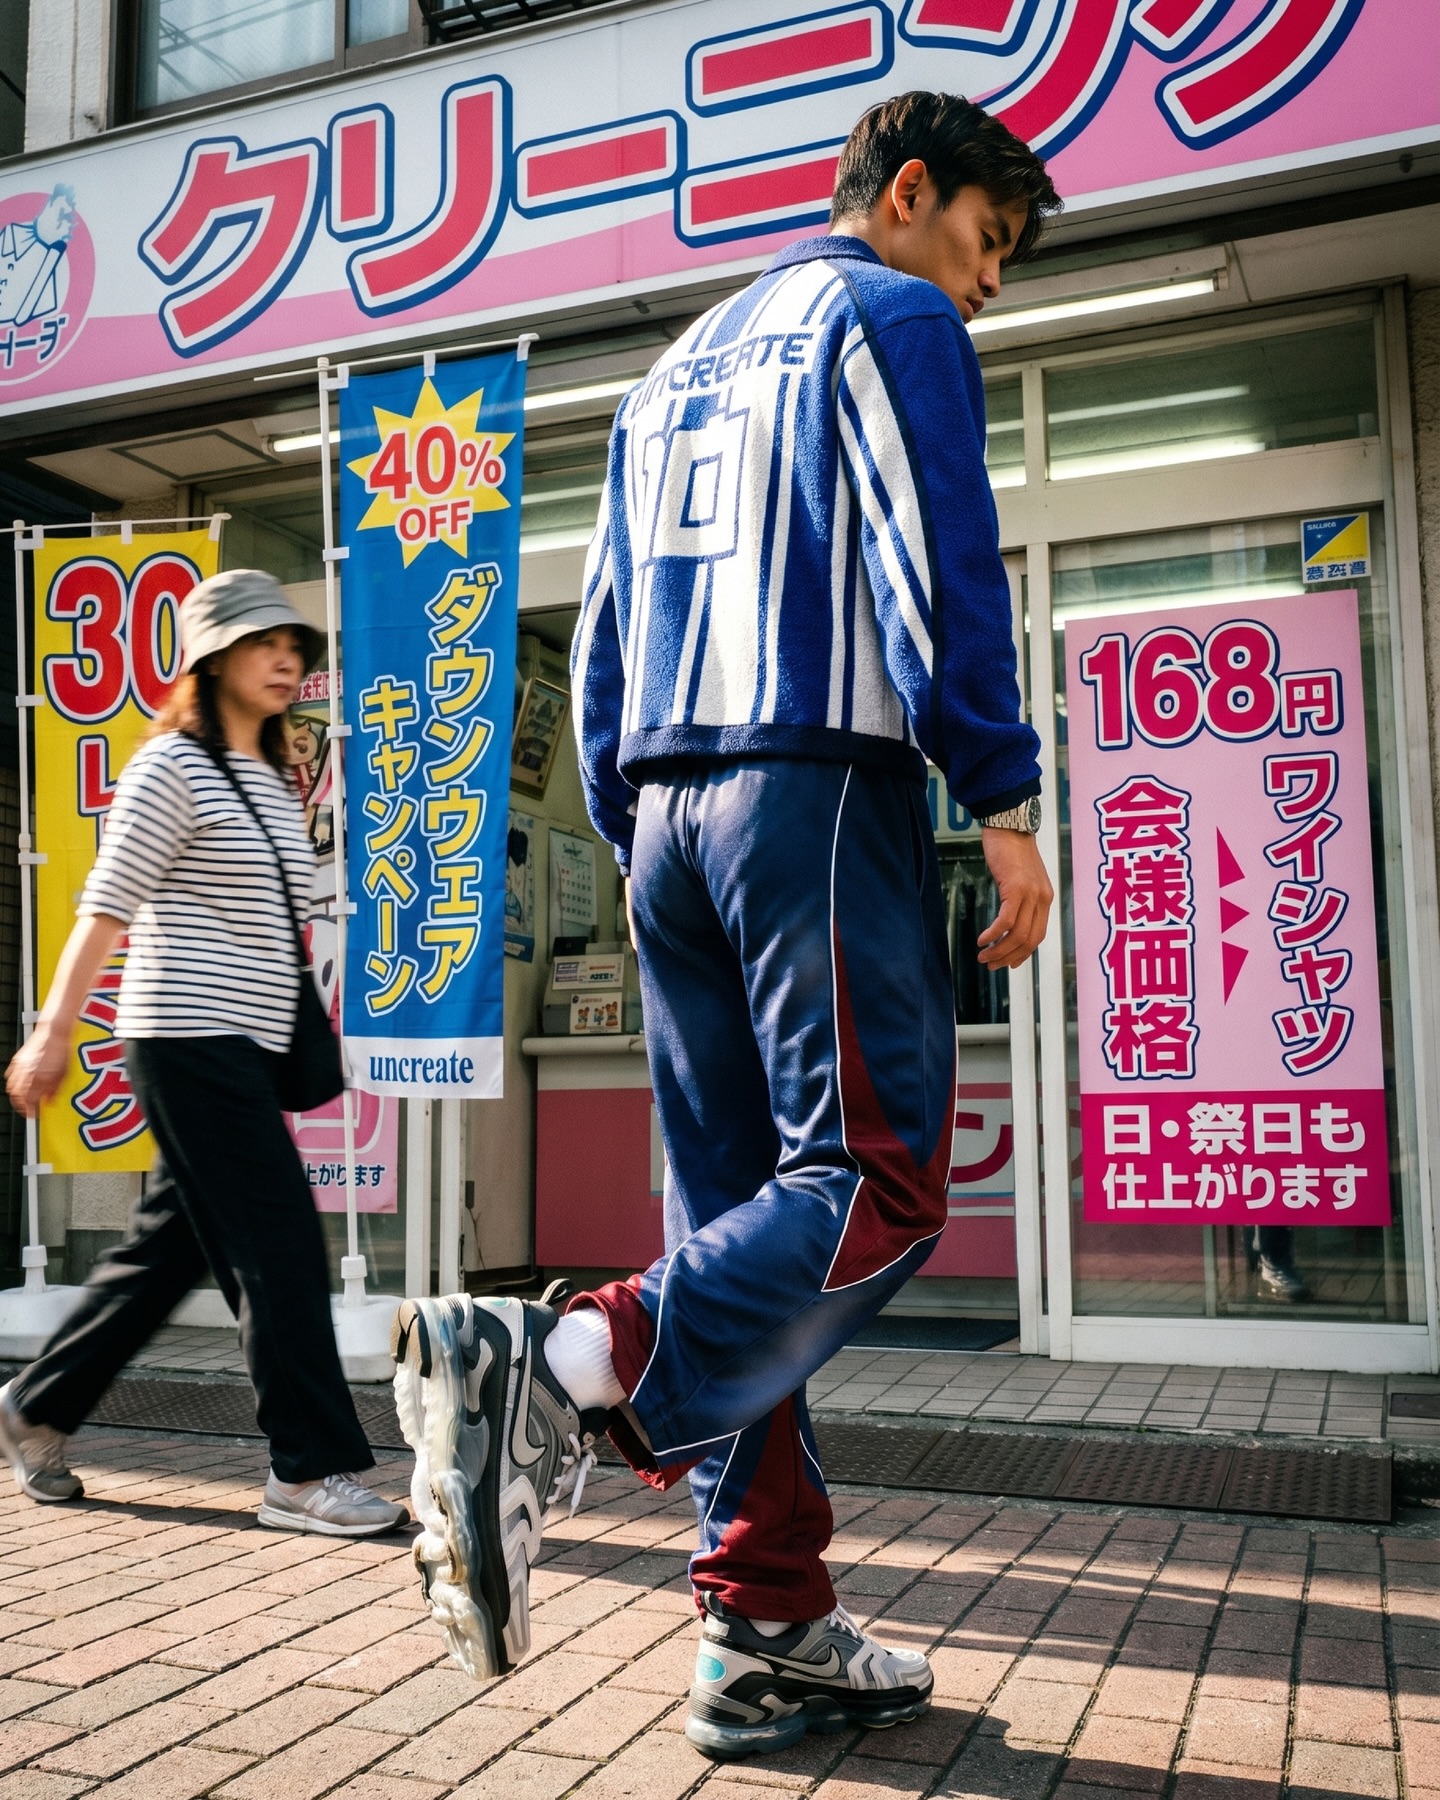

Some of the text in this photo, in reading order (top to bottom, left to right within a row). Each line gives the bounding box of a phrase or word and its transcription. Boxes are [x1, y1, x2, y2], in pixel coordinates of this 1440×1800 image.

[366, 424, 502, 500] 40%
[396, 500, 472, 544] OFF
[1081, 618, 1344, 751] 168円
[418, 564, 501, 1003] ダウンウェア
[358, 674, 421, 1017] キャンペーン
[1094, 775, 1200, 1081] 会様価格
[1263, 751, 1354, 1076] ワイシャツ
[369, 1049, 474, 1084] uncreate
[1103, 1102, 1366, 1155] 日・祭日も
[302, 1163, 386, 1187] 上がります
[1102, 1162, 1368, 1210] 仕上がります
